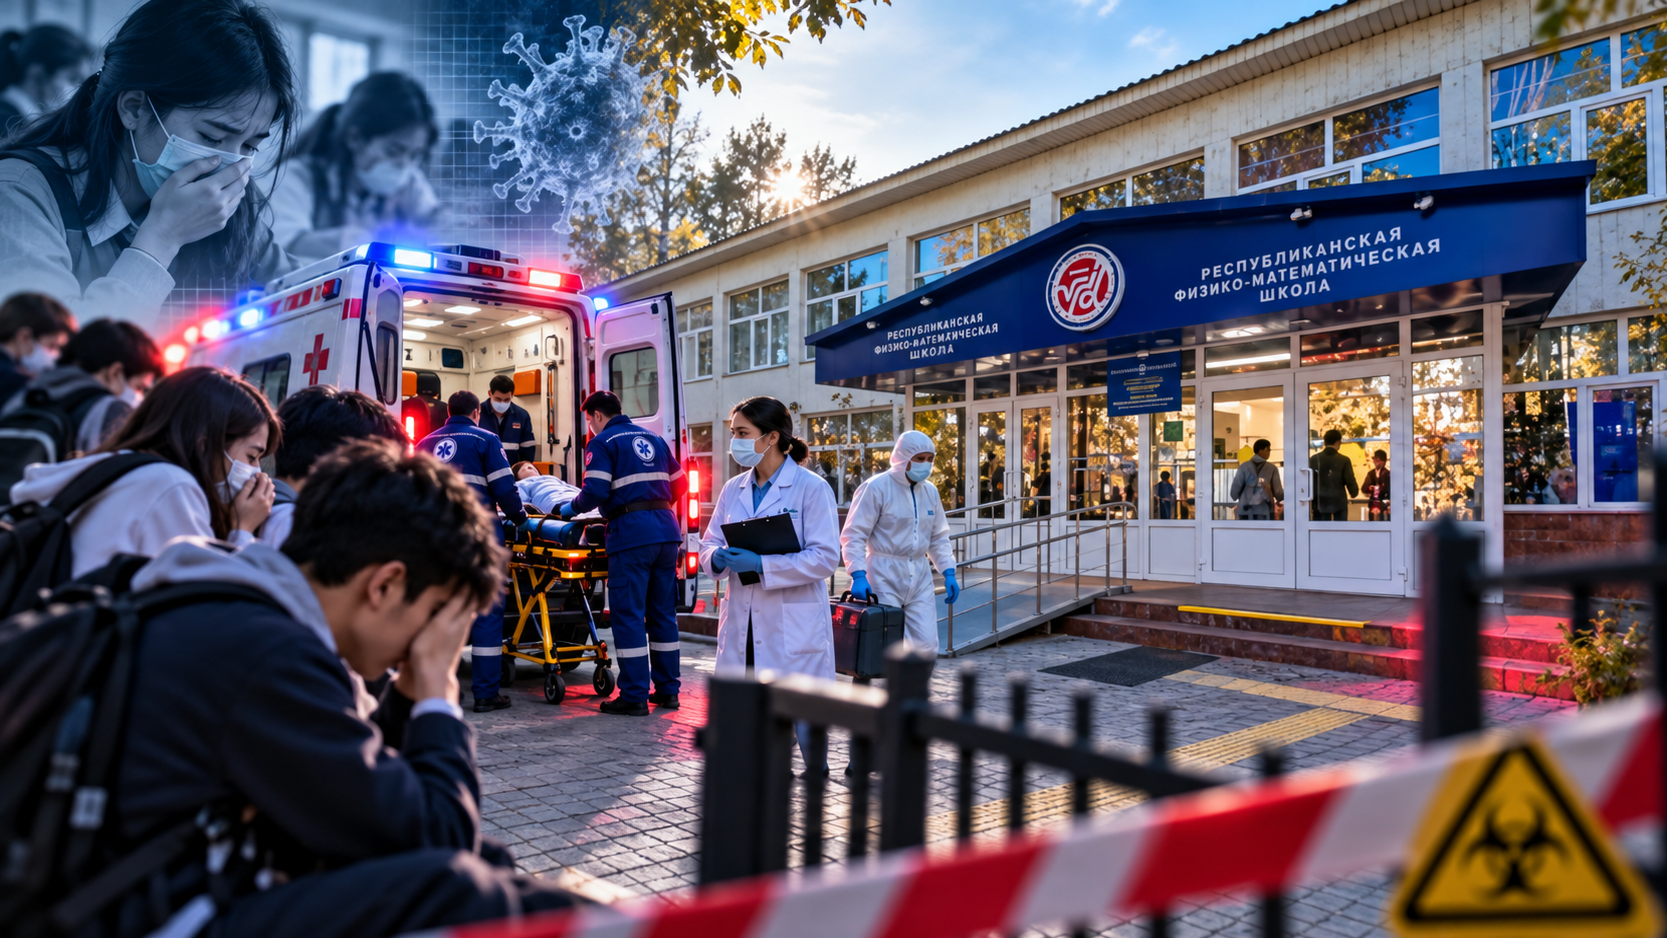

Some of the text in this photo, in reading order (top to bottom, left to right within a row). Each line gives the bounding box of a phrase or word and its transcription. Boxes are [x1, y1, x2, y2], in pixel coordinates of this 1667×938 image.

[1201, 226, 1402, 281] РЕСПУБЛИКАНСКАЯ
[1174, 238, 1441, 302] ФИЗИКО-МАТЕМАТИЧЕСКАЯ
[1259, 278, 1331, 303] ШКОЛА
[887, 312, 983, 341] РЕСПУБЛИКАНСКАЯ
[909, 344, 955, 360] ШКОЛА
